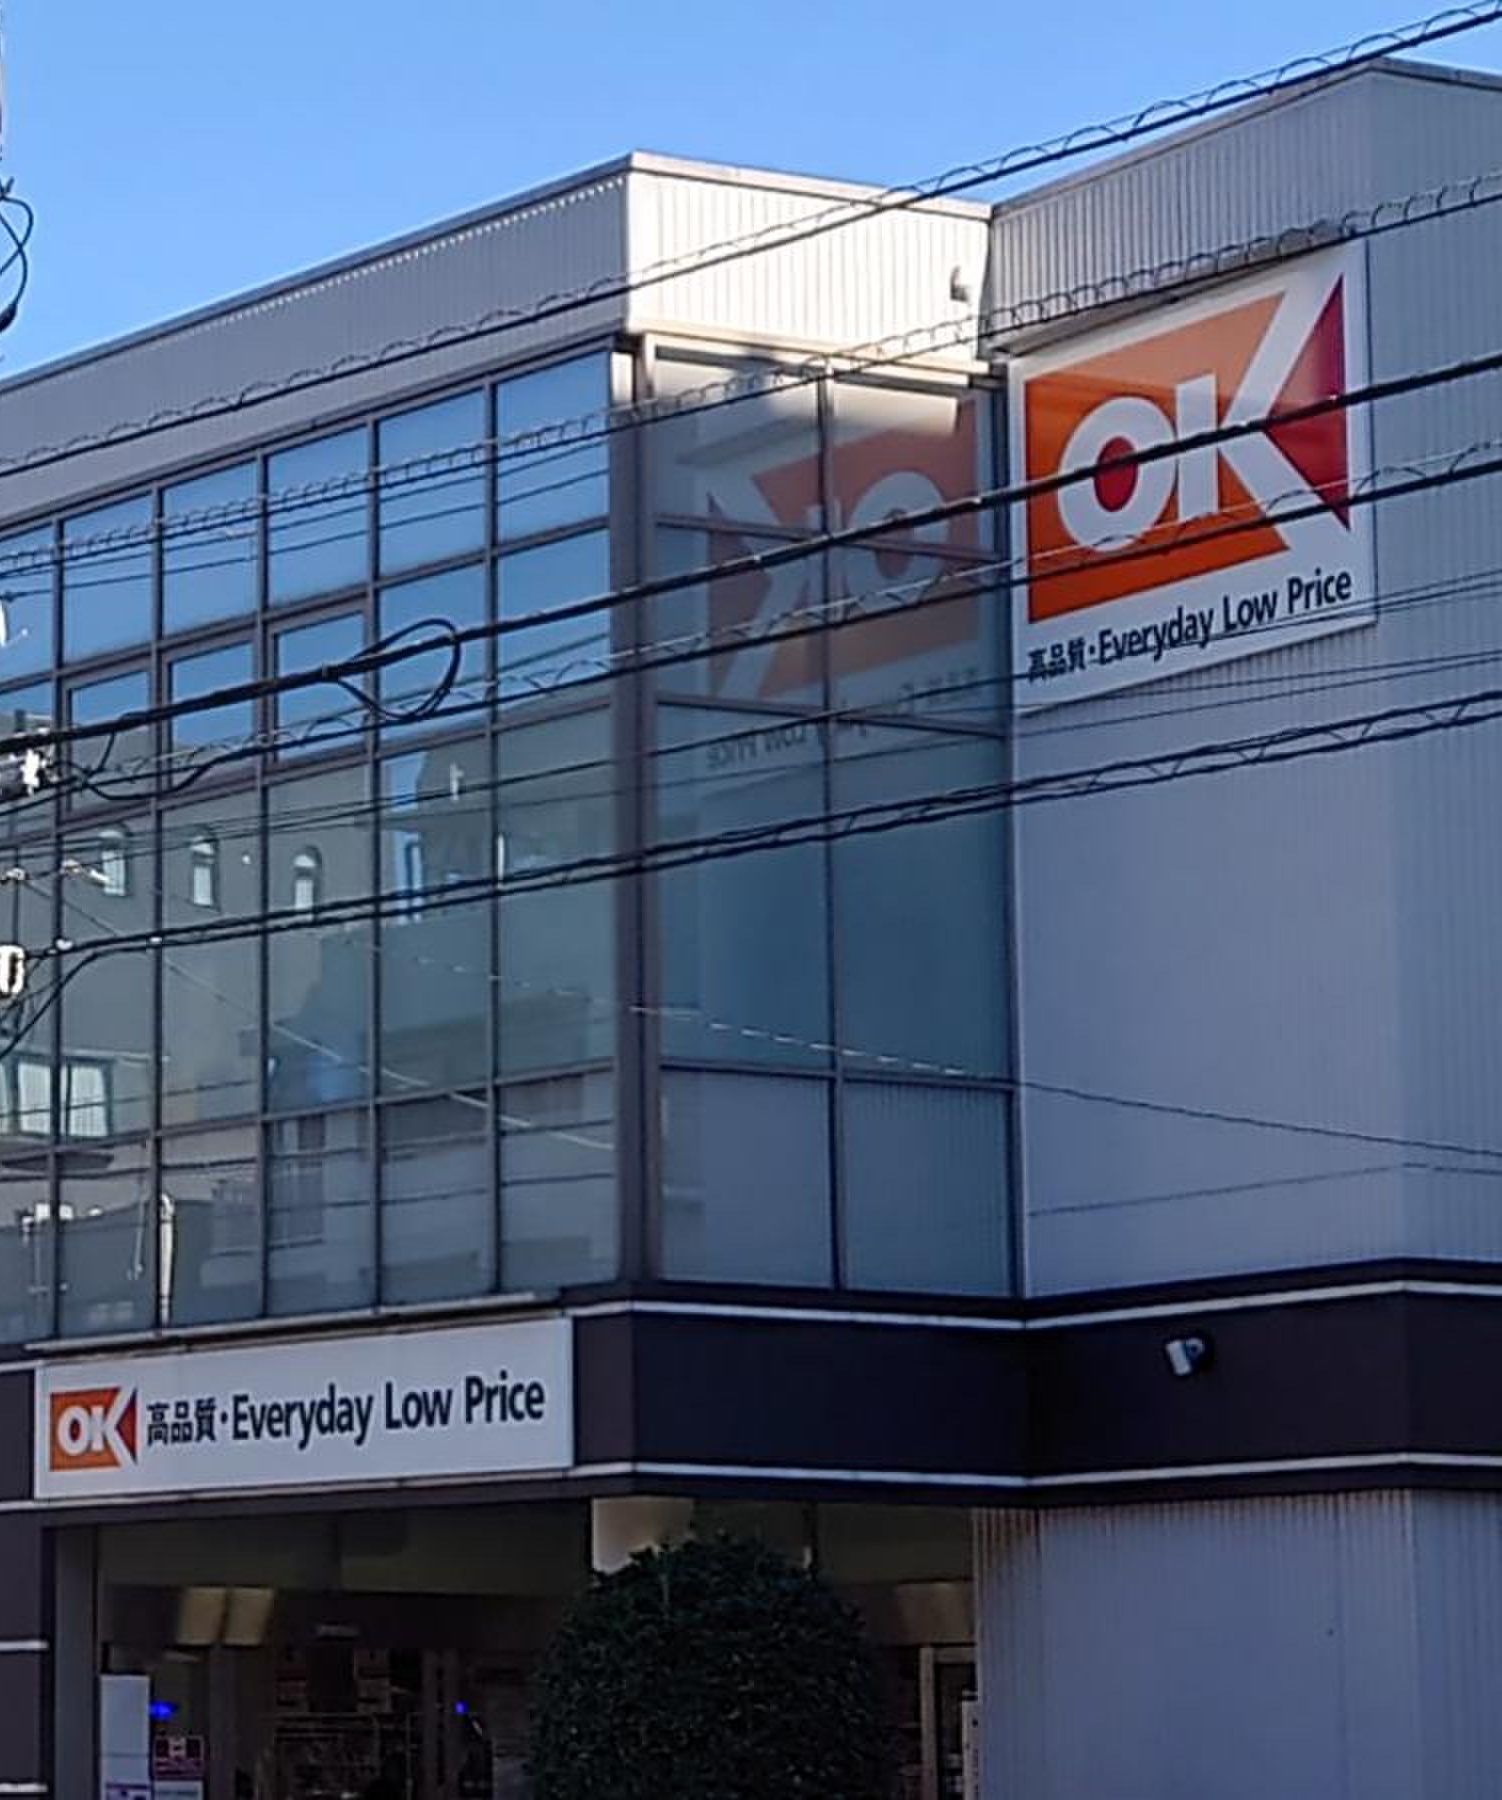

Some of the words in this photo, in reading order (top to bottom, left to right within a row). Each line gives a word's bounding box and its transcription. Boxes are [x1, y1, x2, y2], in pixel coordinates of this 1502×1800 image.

[1056, 274, 1348, 553] OK
[1221, 590, 1279, 632] Low
[1287, 567, 1352, 614] Price
[56, 1387, 138, 1465] OK
[384, 1381, 453, 1432] Low
[464, 1369, 546, 1426] Price
